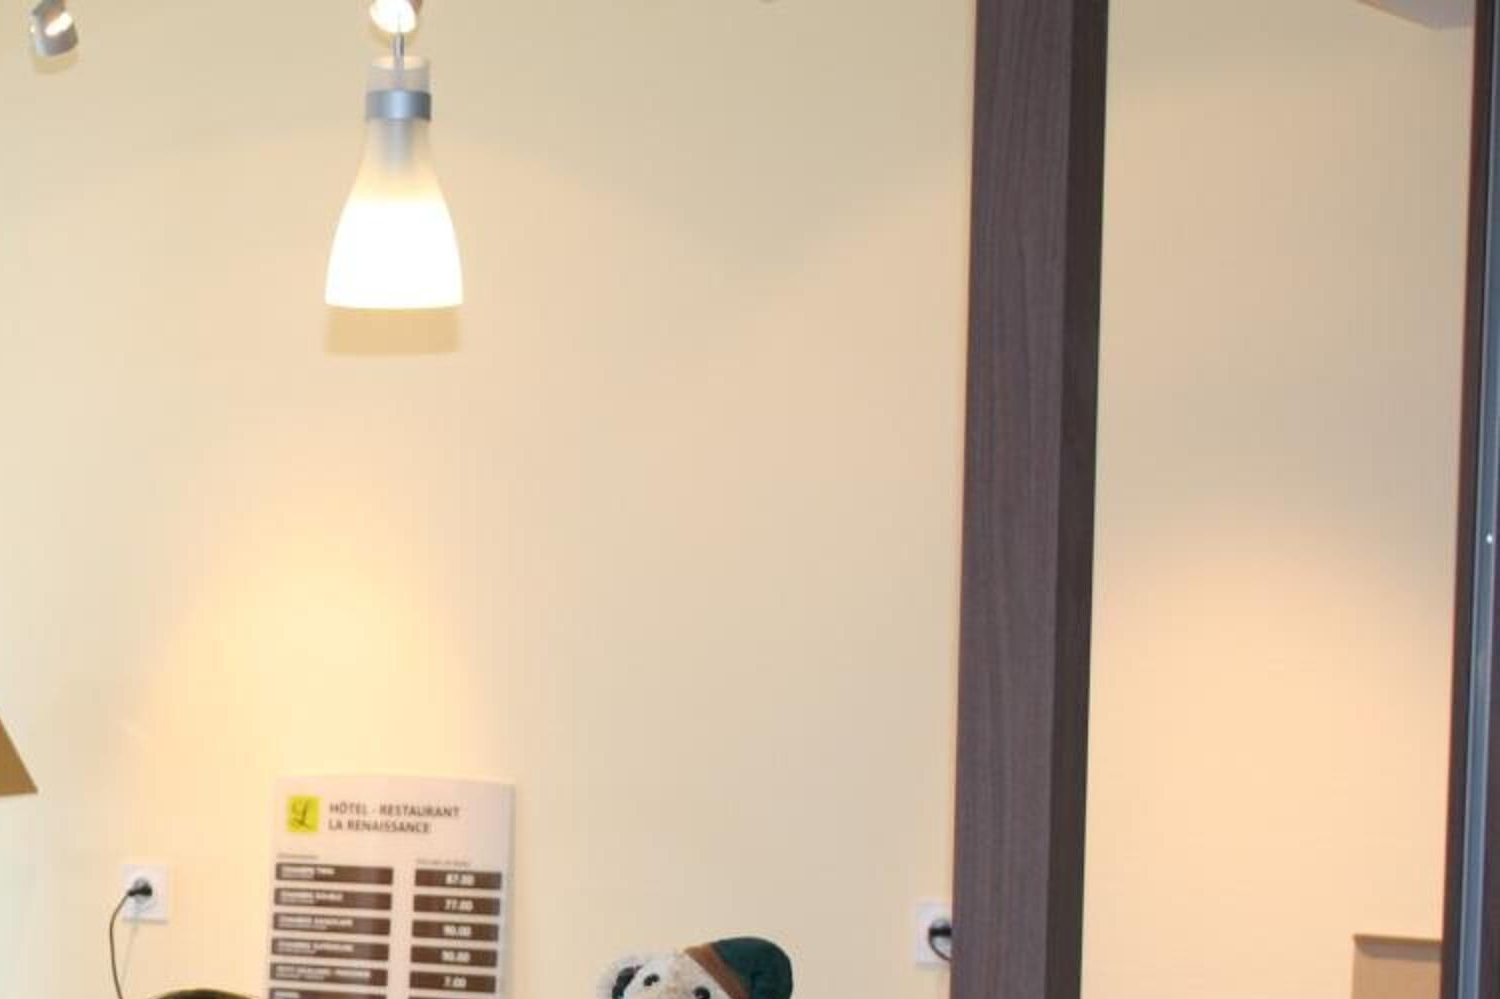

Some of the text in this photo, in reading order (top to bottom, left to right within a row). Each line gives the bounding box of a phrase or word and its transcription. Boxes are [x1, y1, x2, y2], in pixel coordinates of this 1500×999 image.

[329, 800, 367, 816] HÔTEL
[379, 804, 460, 817] RESTAURANT
[328, 819, 431, 833] LA RENAISSANCE
